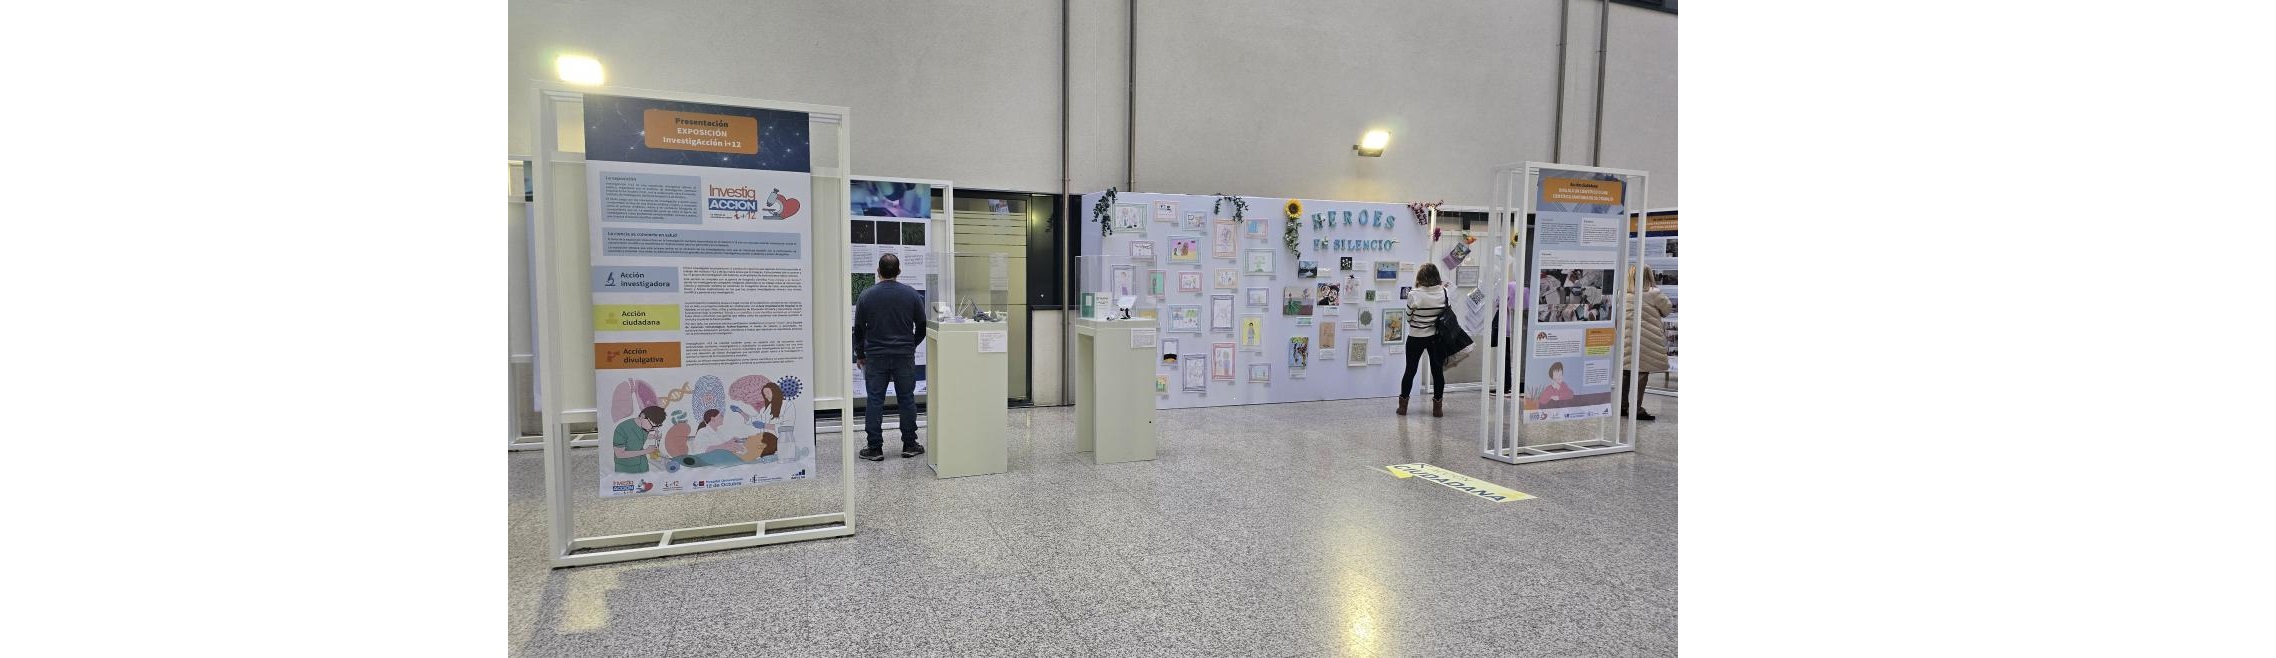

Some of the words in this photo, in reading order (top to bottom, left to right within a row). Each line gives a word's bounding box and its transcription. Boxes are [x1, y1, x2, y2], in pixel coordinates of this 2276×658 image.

[675, 117, 729, 128] Presentación
[677, 127, 728, 137] EXPOSICIÓN
[663, 136, 723, 147] InvestigAcción
[724, 139, 742, 148] i+12
[709, 184, 756, 201] Investig
[1312, 209, 1396, 232] HEROES
[1333, 239, 1393, 252] SILENCIO
[620, 280, 671, 289] investigadora
[623, 356, 665, 365] divulgativa
[1394, 465, 1508, 502] CIUDADANA
